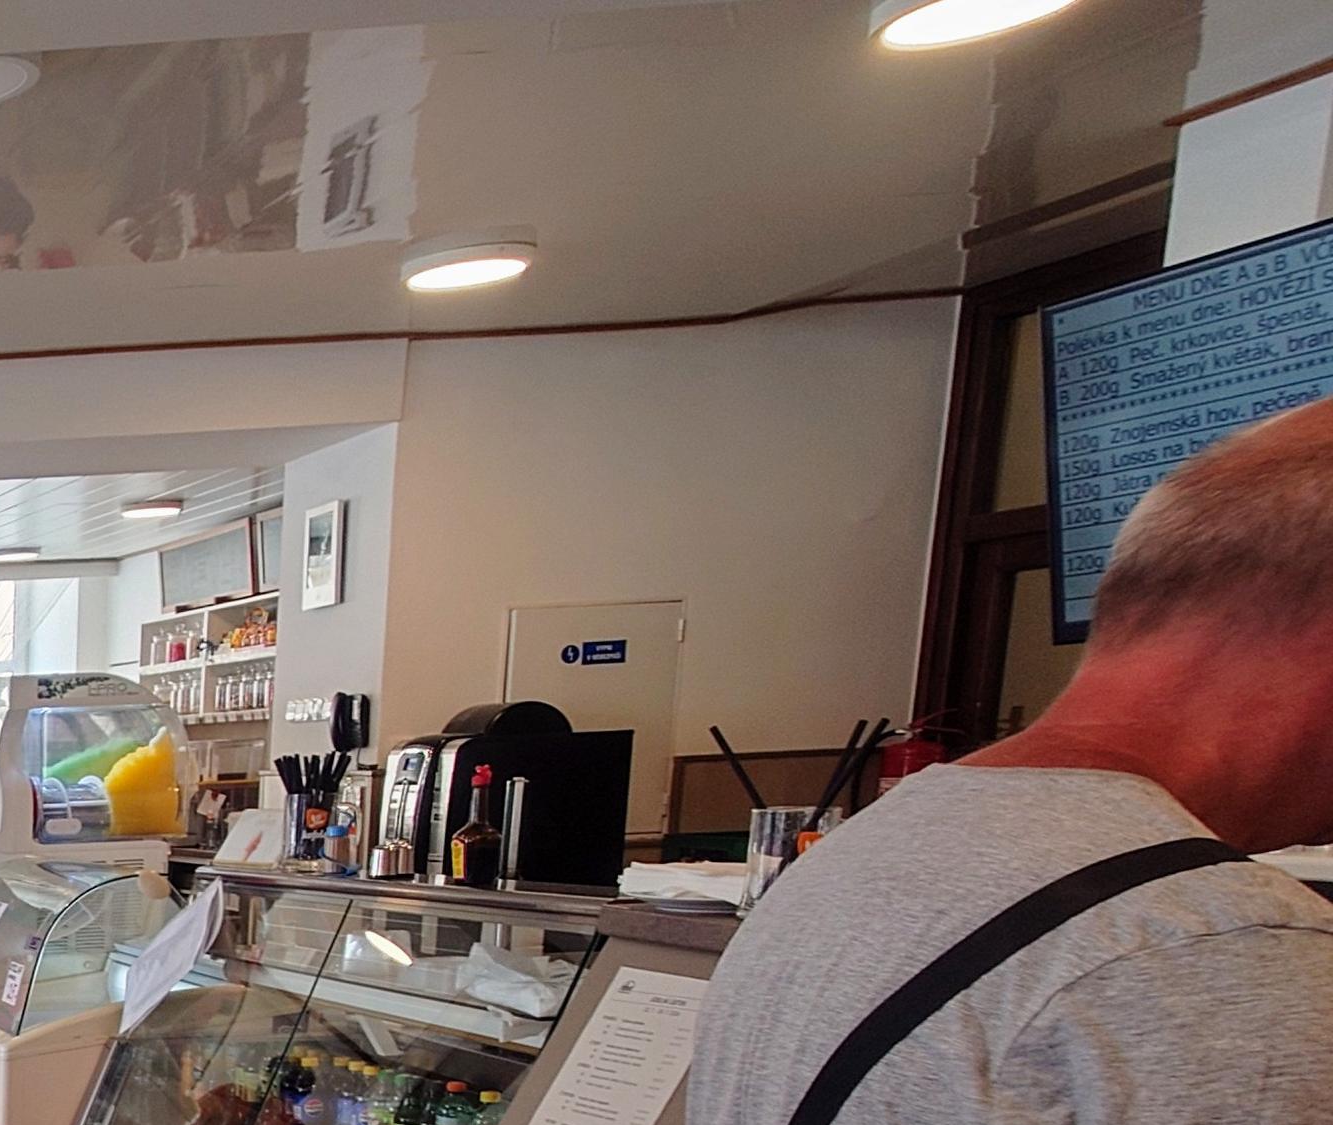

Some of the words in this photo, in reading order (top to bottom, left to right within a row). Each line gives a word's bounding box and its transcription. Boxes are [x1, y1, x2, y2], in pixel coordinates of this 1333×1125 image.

[1133, 281, 1184, 310] MENU
[1191, 270, 1230, 296] DNE
[1235, 265, 1251, 282] A
[1256, 264, 1267, 278] a
[1274, 254, 1287, 272] B
[1056, 330, 1118, 357] Polévka
[1122, 325, 1132, 340] k
[1137, 313, 1185, 335] menu
[1191, 300, 1231, 322] dne:
[1239, 270, 1316, 309] HOVĚZÍ
[1058, 366, 1068, 382] A
[1080, 354, 1118, 377] 120g
[1129, 340, 1165, 364] Peč.
[1058, 389, 1070, 406] B
[1081, 380, 1120, 402] 200g
[1130, 354, 1207, 390] Smažený
[1063, 433, 1100, 455] 120g
[1110, 410, 1200, 445] Znojemská
[1207, 405, 1246, 425] hov.
[1063, 457, 1100, 479] 150g
[1110, 448, 1158, 469] Losos
[1162, 442, 1184, 459] na
[1065, 480, 1102, 502] 120g
[1111, 471, 1152, 494] Játra
[1066, 505, 1102, 526] 120g
[1067, 553, 1104, 573] 120g
